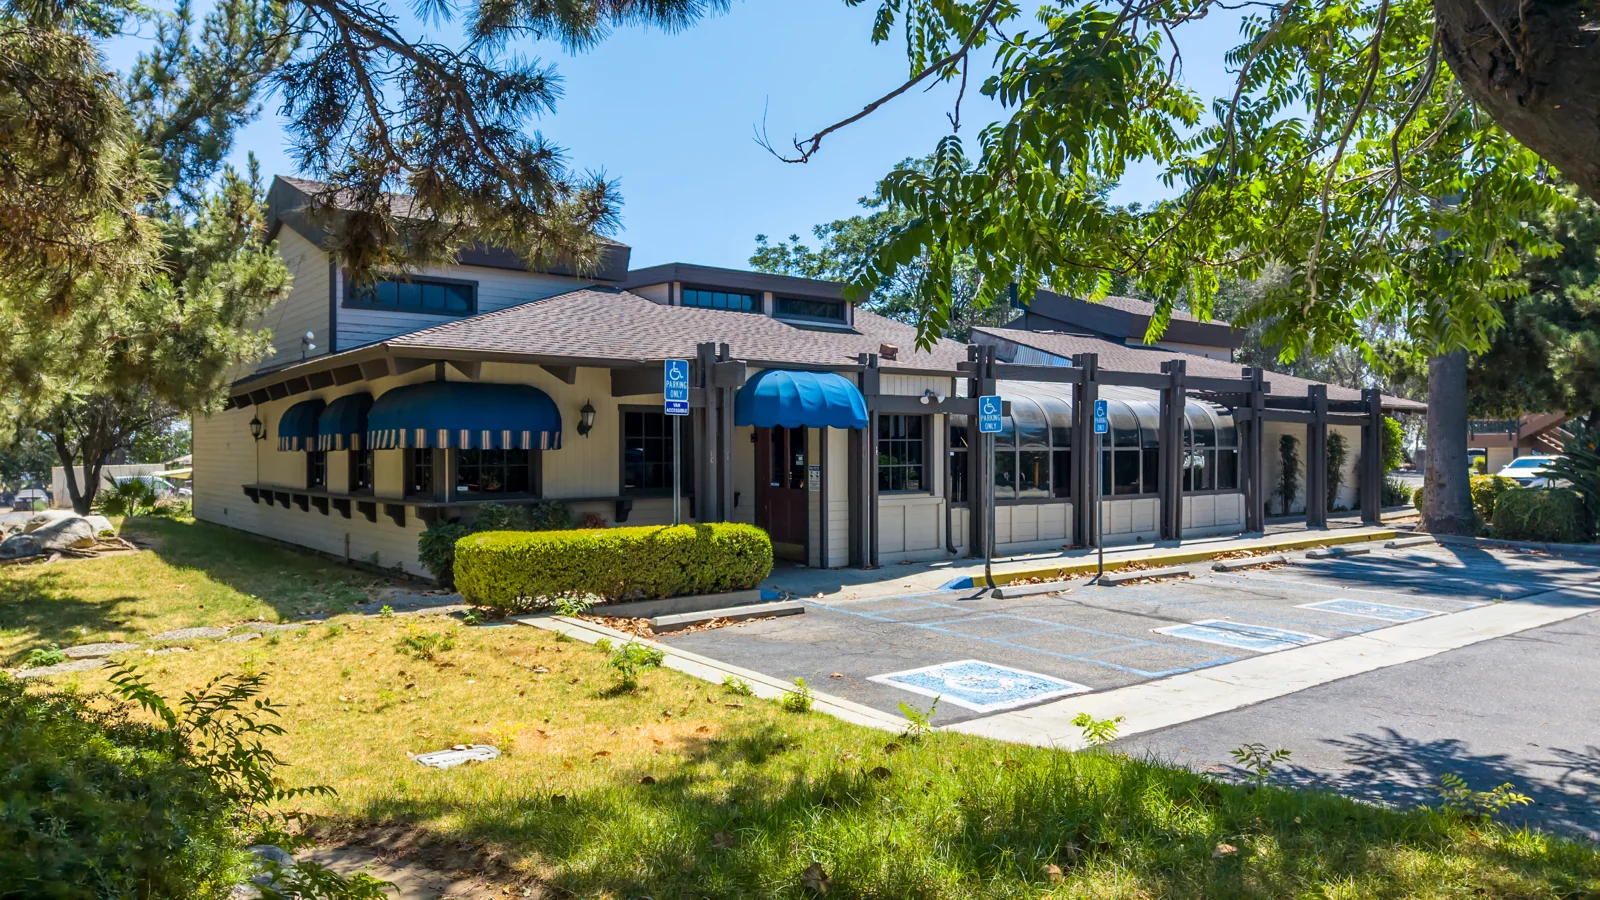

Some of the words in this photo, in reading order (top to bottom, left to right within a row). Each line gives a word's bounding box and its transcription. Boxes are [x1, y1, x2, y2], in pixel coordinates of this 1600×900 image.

[666, 380, 687, 389] PARKING
[670, 390, 683, 398] ONLY
[980, 414, 1001, 422] PARKING
[984, 422, 997, 430] ONLY
